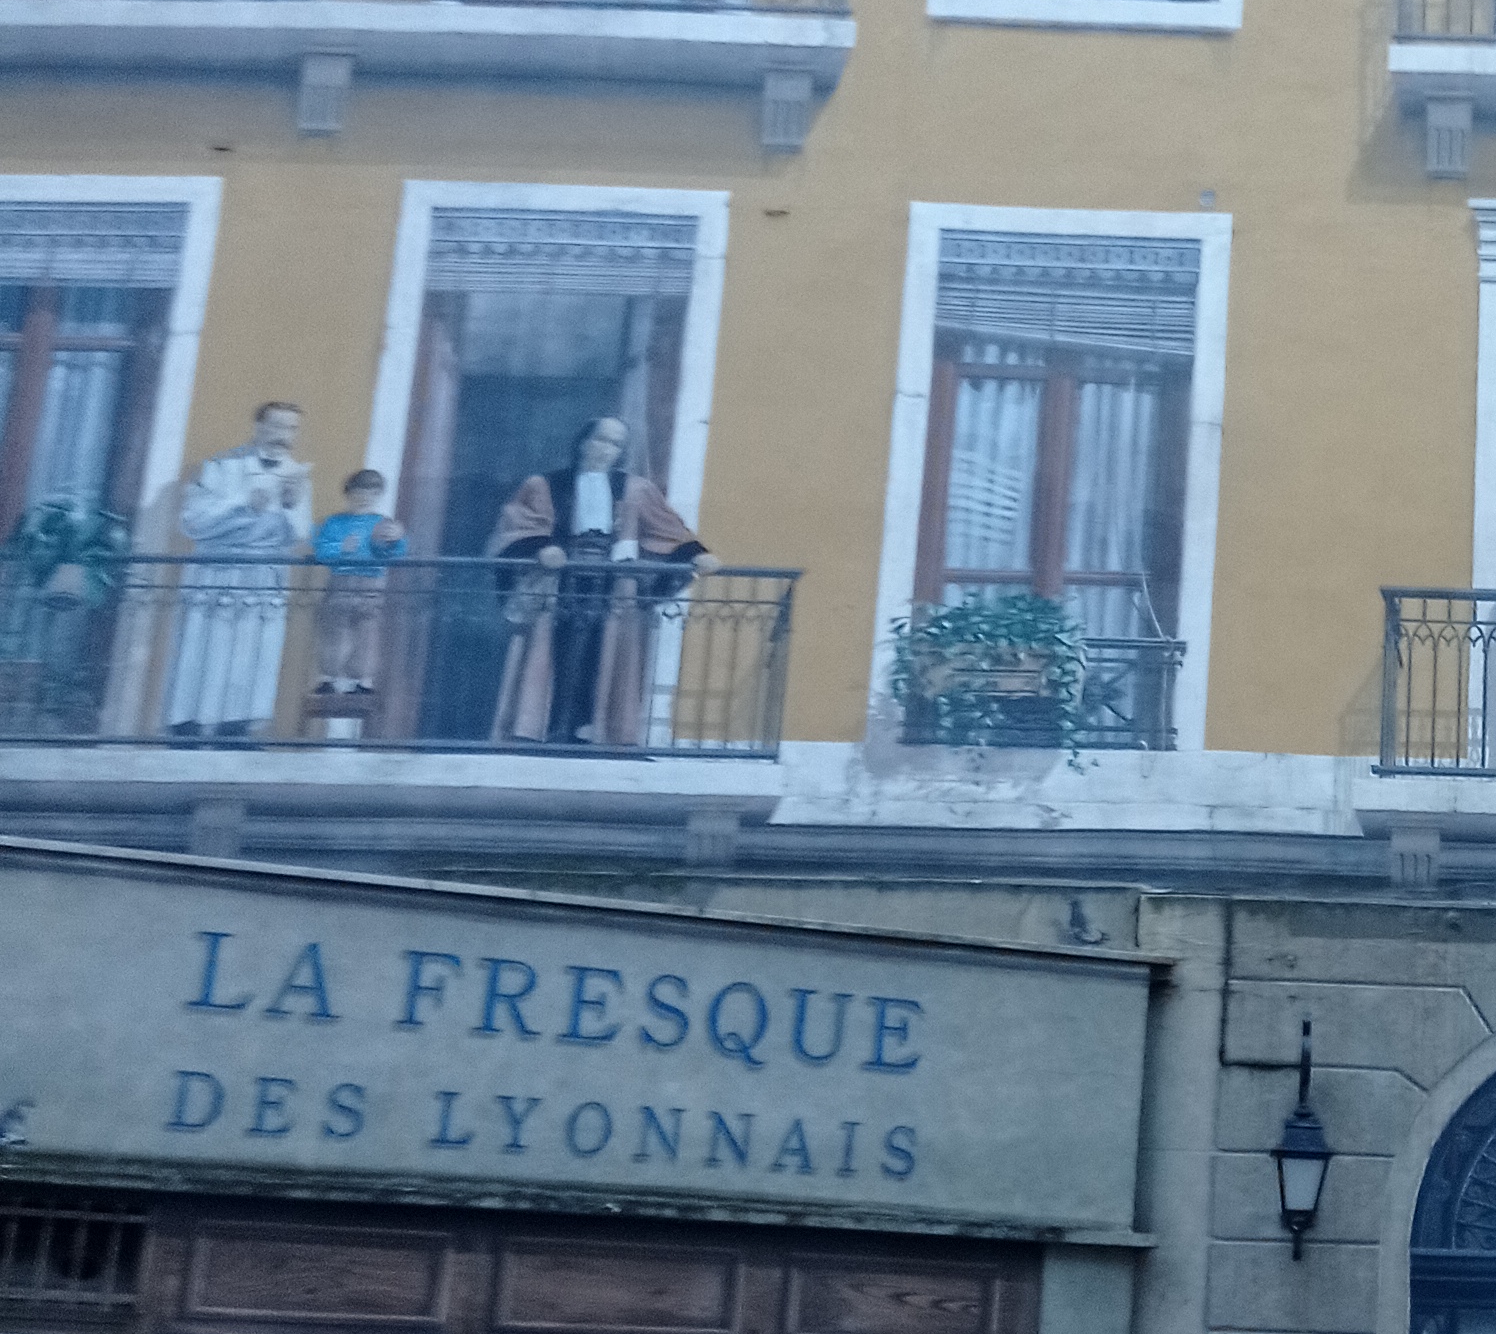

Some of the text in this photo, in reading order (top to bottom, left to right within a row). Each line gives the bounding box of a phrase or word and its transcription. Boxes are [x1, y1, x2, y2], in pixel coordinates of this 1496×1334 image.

[185, 931, 926, 1073] LA FRESQUE
[164, 1069, 917, 1180] DES LYONNAIS
